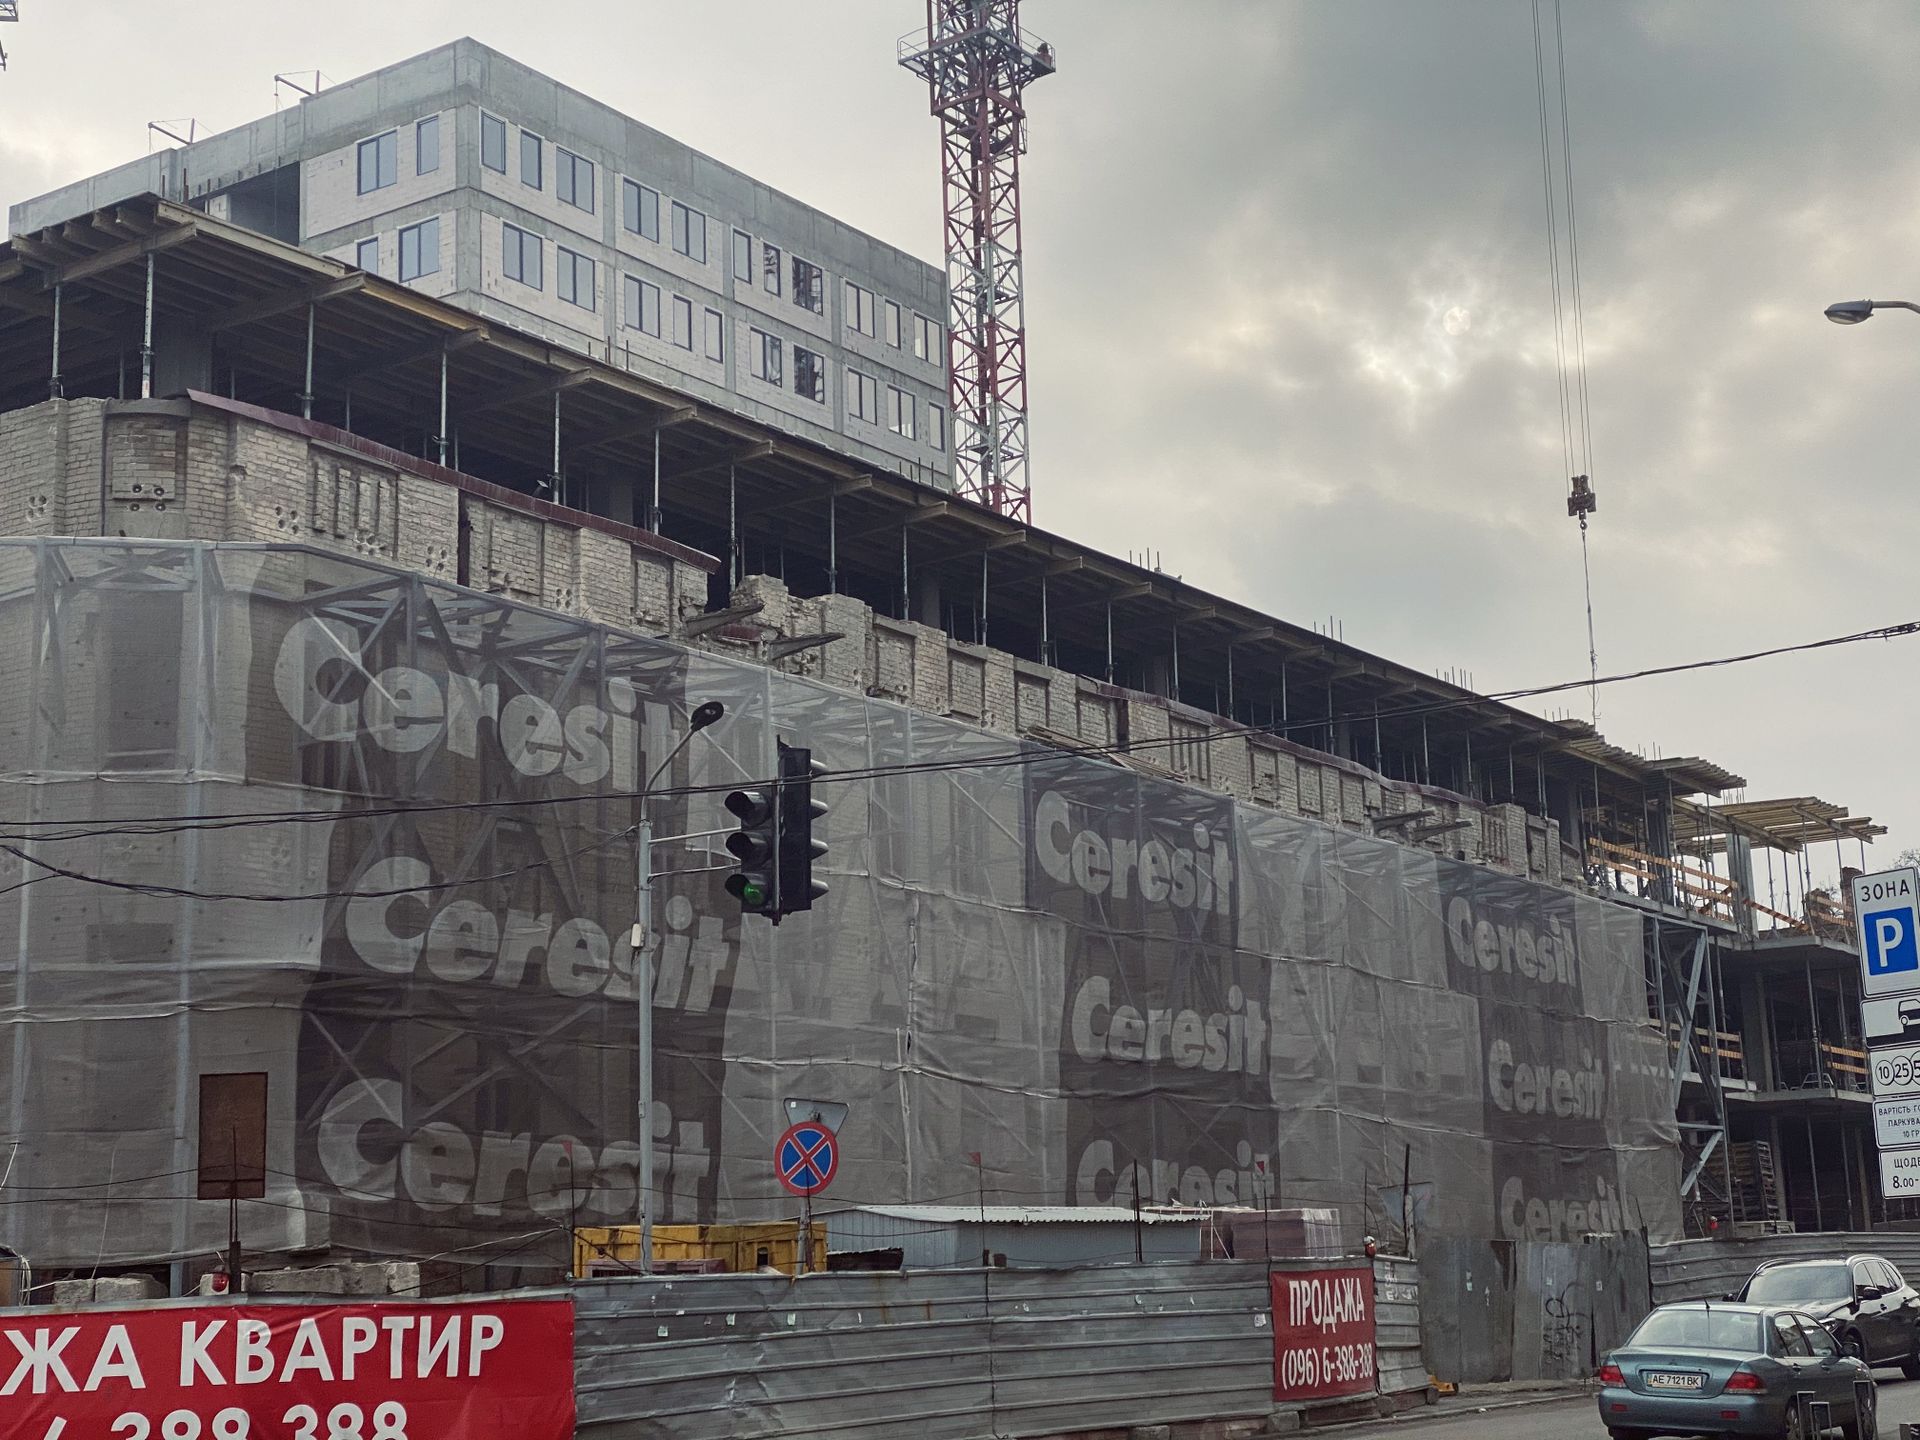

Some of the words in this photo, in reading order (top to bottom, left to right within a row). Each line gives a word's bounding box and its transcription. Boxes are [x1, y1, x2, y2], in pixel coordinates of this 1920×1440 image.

[273, 617, 679, 801] Ceresit
[1035, 790, 1233, 916] Ceresit
[1861, 879, 1910, 902] ЗОНА
[345, 856, 730, 1014] Ceresit
[1448, 896, 1577, 987] Ceresit
[1876, 917, 1903, 967] P
[1071, 975, 1267, 1075] Ceresit
[1488, 1039, 1605, 1120] Ceresit
[1879, 1066, 1890, 1079] 10
[1895, 1063, 1909, 1078] 25
[1878, 1105, 1911, 1116] ВАРТІСТЬ
[1903, 1130, 1910, 1138] 10
[317, 1078, 711, 1224] Ceresit
[1289, 1277, 1365, 1334] ПРОДАЖА
[0, 1324, 146, 1395] ЖА
[180, 1315, 504, 1387] КВАРТИР
[1282, 1347, 1319, 1390] (096)
[1323, 1342, 1374, 1384] 6-388-388
[1653, 1374, 1664, 1384] AE
[1667, 1375, 1685, 1385] 7121
[1687, 1376, 1699, 1386] BK
